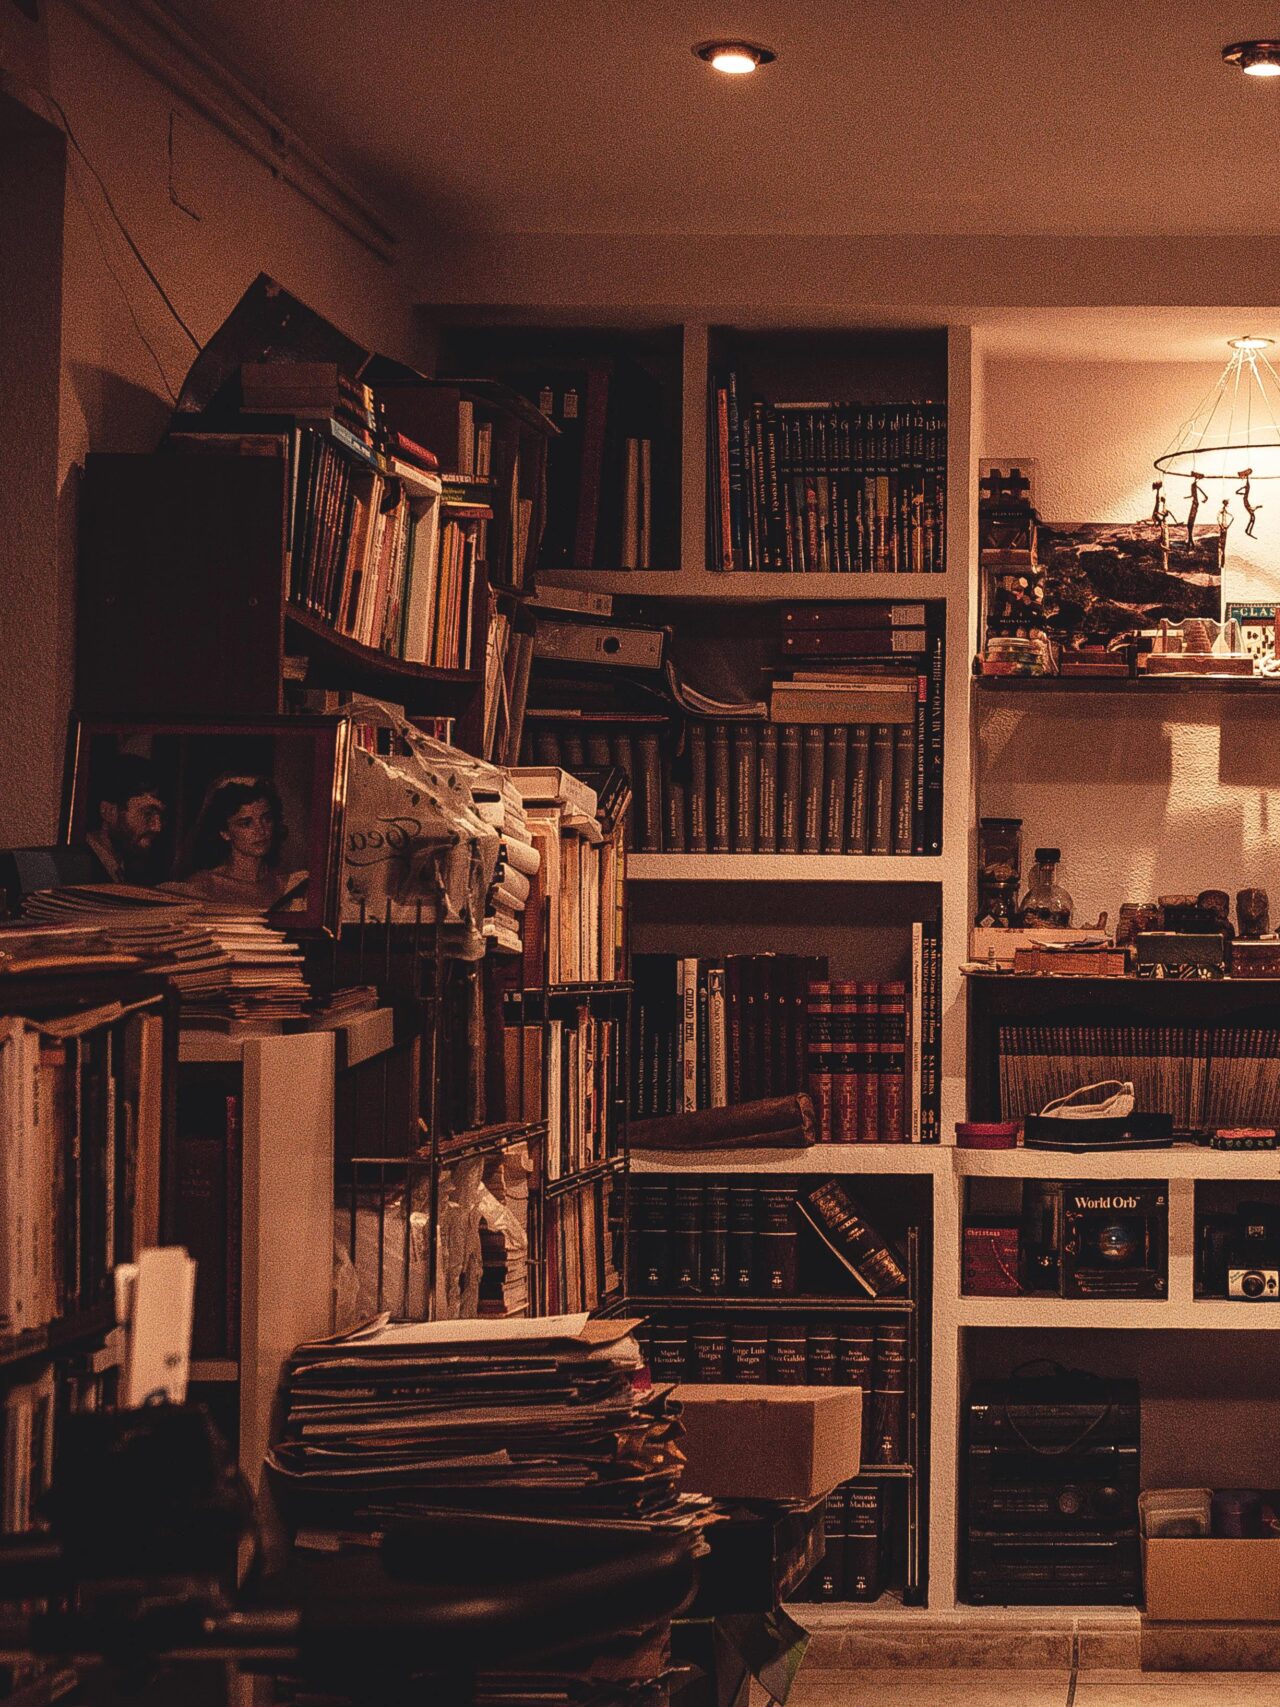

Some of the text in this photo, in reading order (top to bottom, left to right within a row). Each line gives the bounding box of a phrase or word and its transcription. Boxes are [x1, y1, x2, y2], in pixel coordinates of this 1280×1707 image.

[810, 729, 819, 737] 16
[833, 727, 842, 736] 17
[856, 728, 865, 737] 18
[879, 727, 888, 736] 19
[902, 728, 911, 737] 20
[685, 988, 694, 1043] CIUDAD REAL
[1074, 1196, 1137, 1209] World Orb
[966, 1229, 1001, 1237] Christmas
[732, 1346, 766, 1356] Jorge Luis
